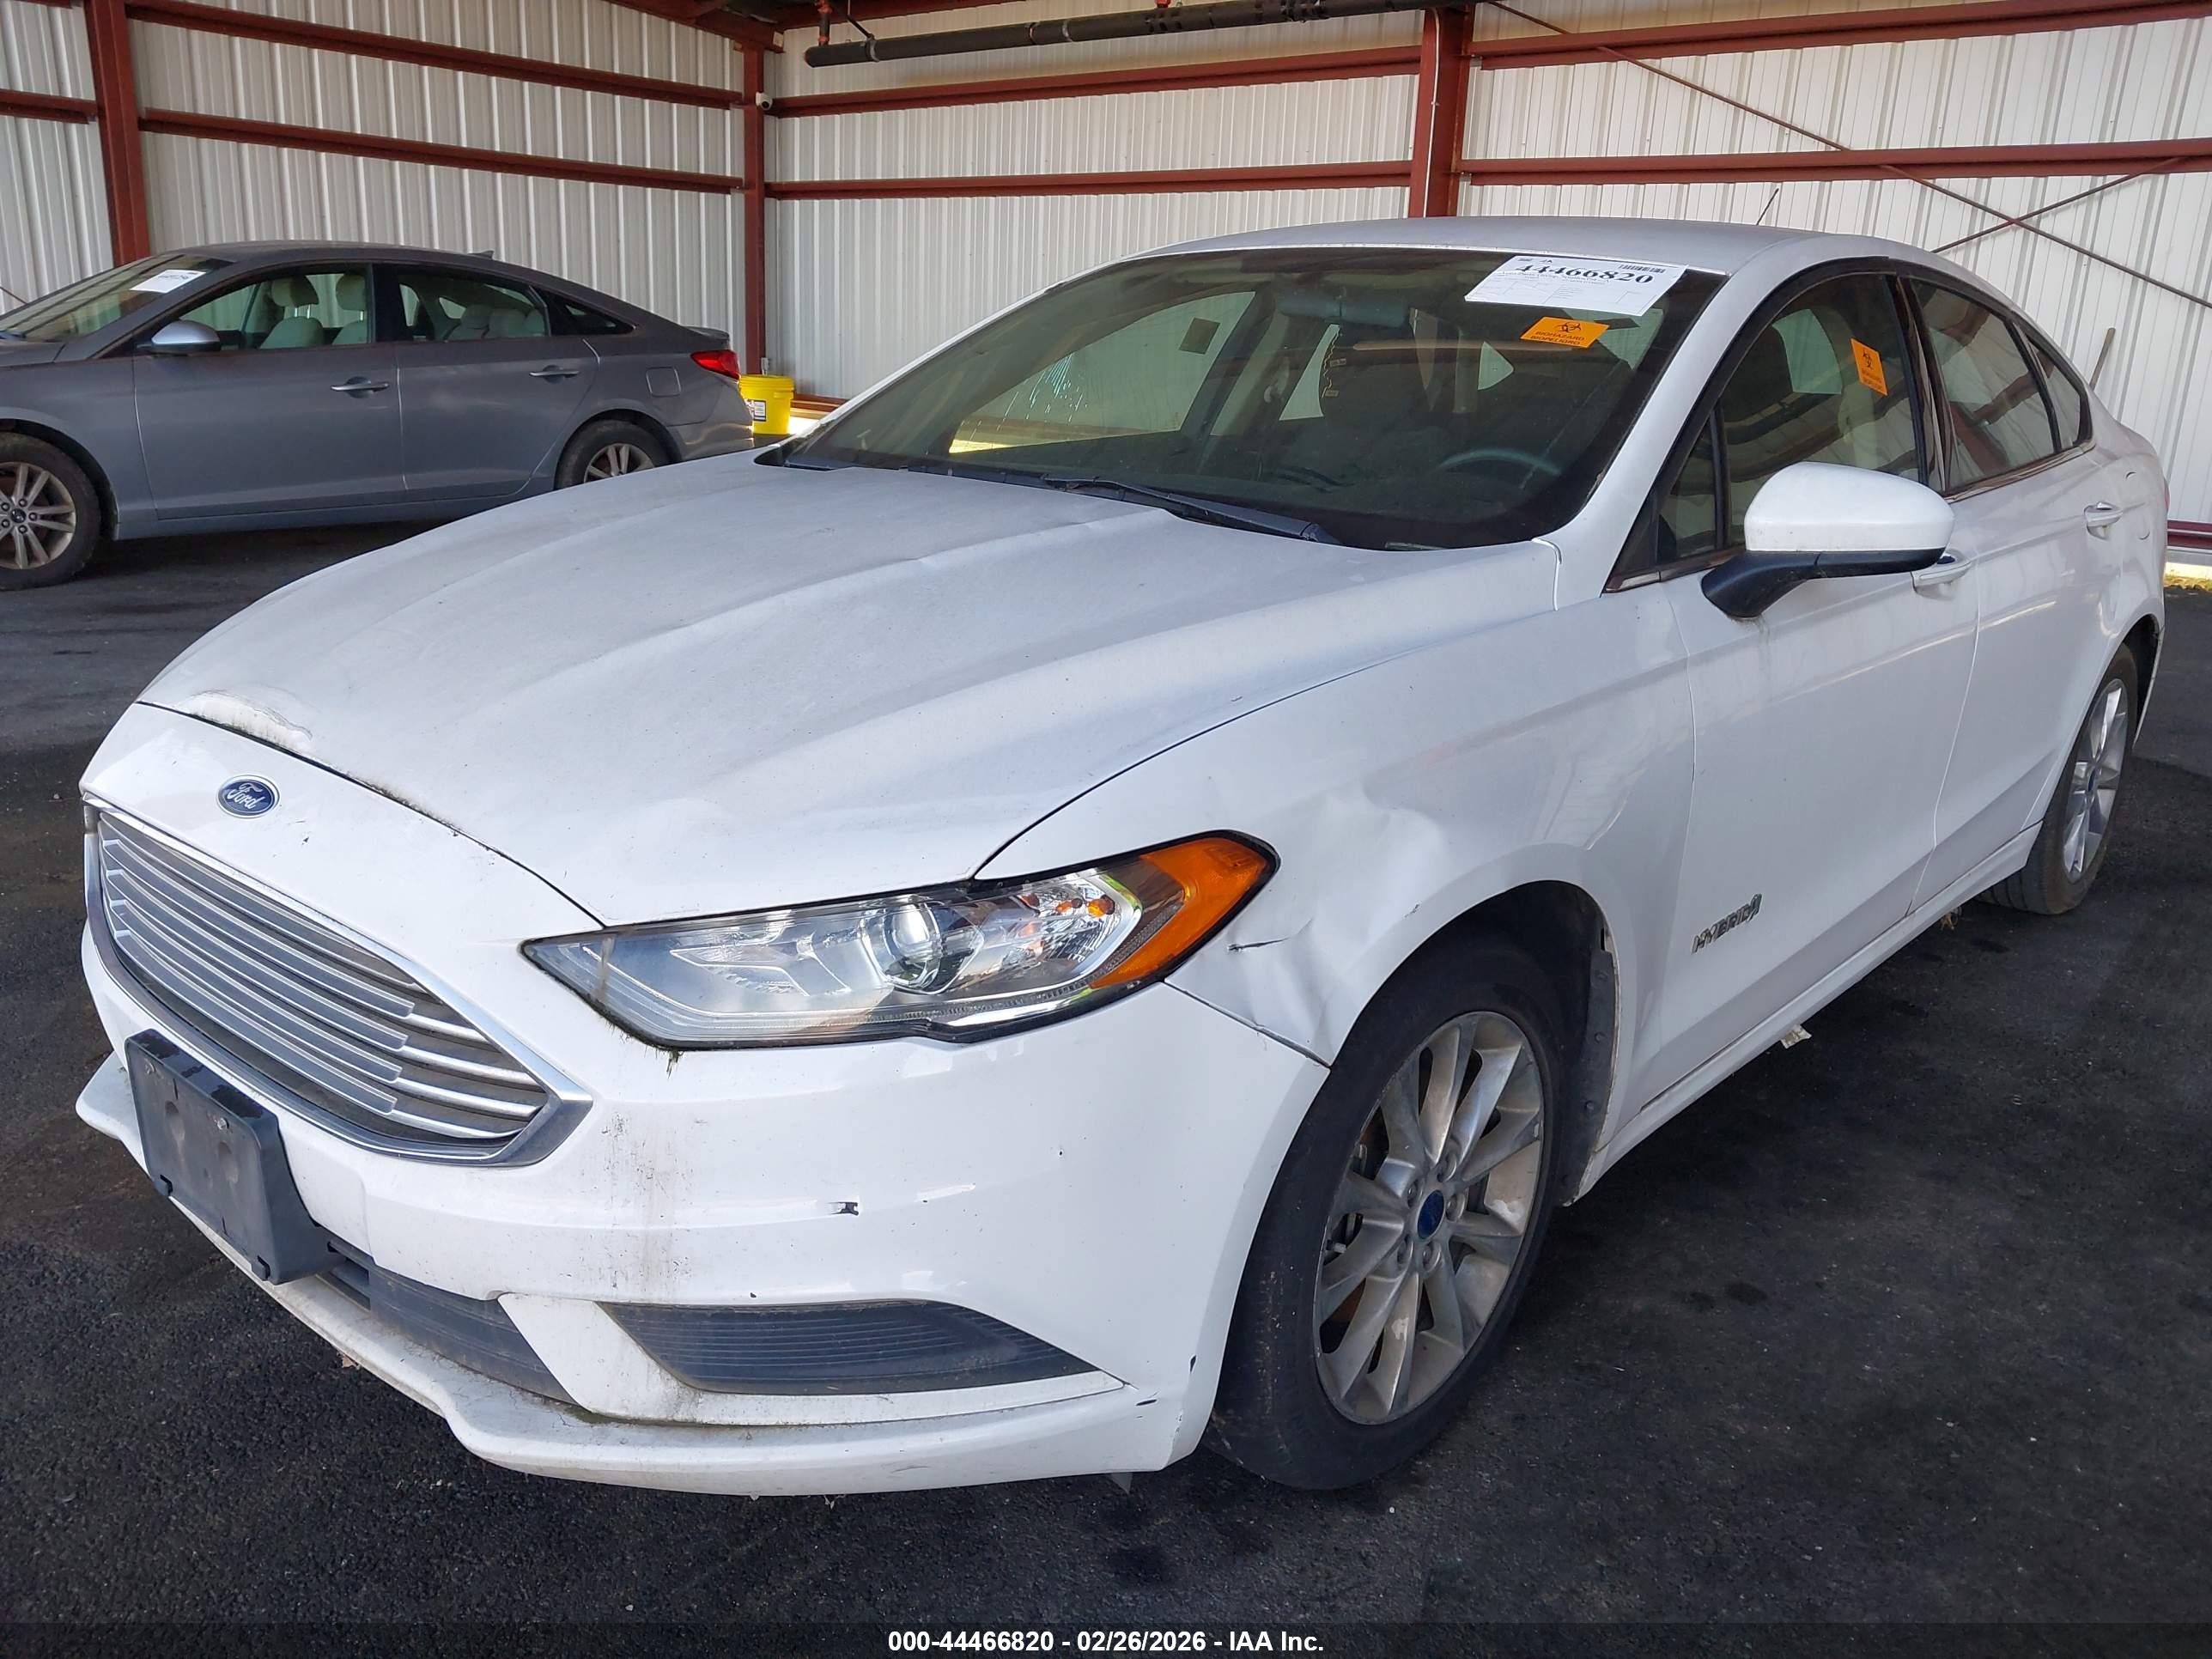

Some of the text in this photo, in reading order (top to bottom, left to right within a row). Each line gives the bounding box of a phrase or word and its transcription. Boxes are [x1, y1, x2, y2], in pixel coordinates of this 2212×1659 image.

[1516, 264, 1654, 283] 44466820
[1534, 331, 1585, 342] BIOHAZARD
[226, 782, 266, 810] Ford
[1692, 902, 1754, 954] HYBRID
